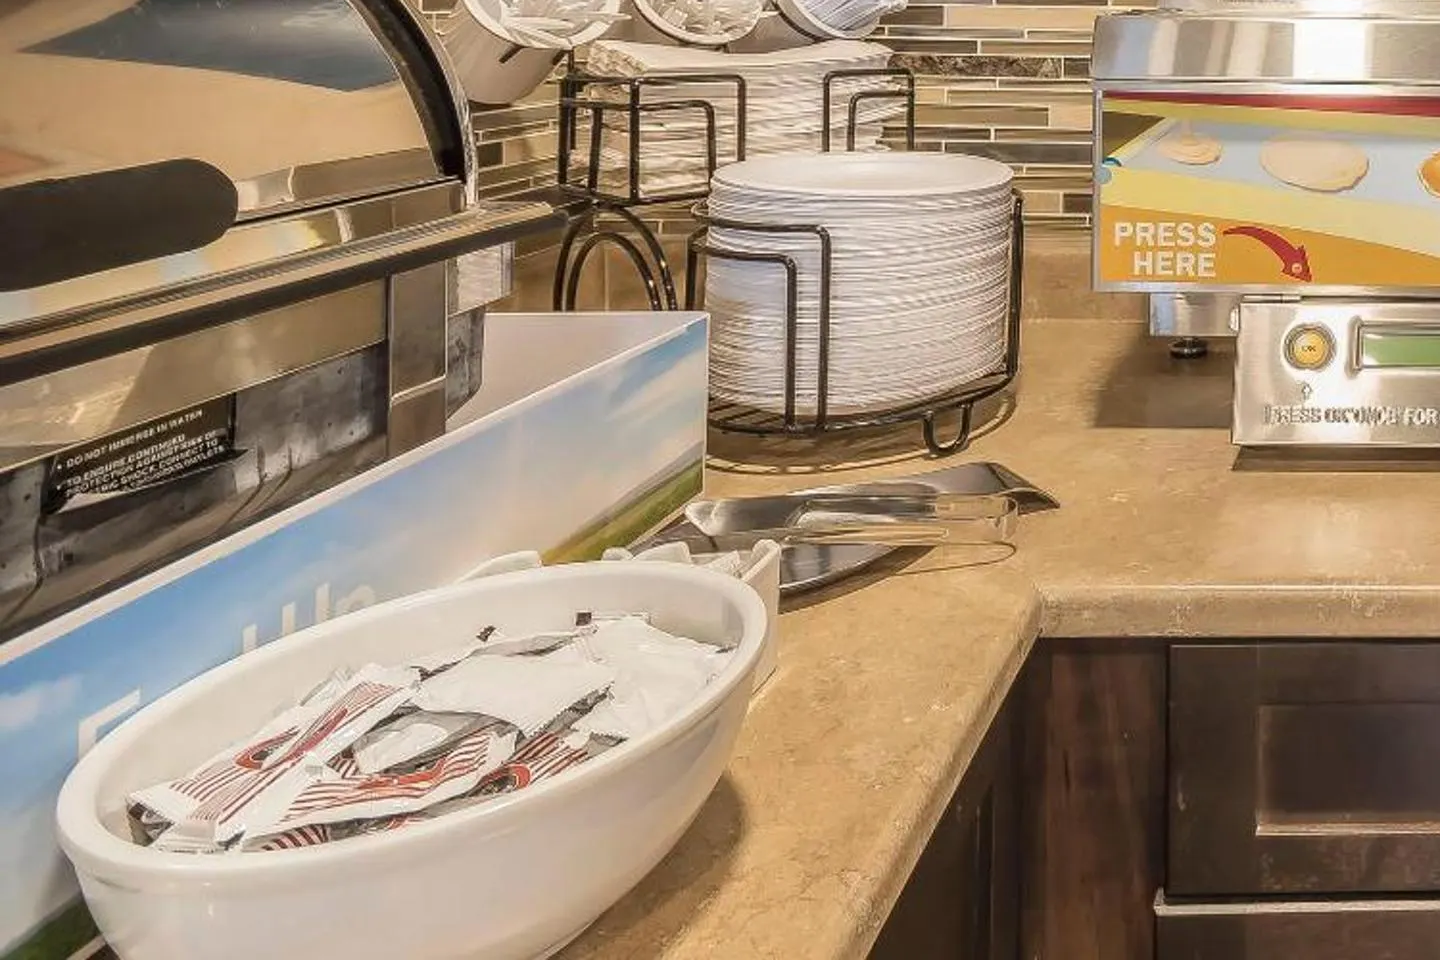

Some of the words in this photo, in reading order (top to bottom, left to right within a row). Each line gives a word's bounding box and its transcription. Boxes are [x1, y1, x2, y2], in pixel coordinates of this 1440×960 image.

[1114, 222, 1216, 247] PRESS
[1133, 251, 1216, 277] HERE
[1264, 405, 1321, 424] PRESS
[1403, 407, 1438, 426] FOR
[84, 445, 108, 462] NOT
[157, 422, 168, 434] IN
